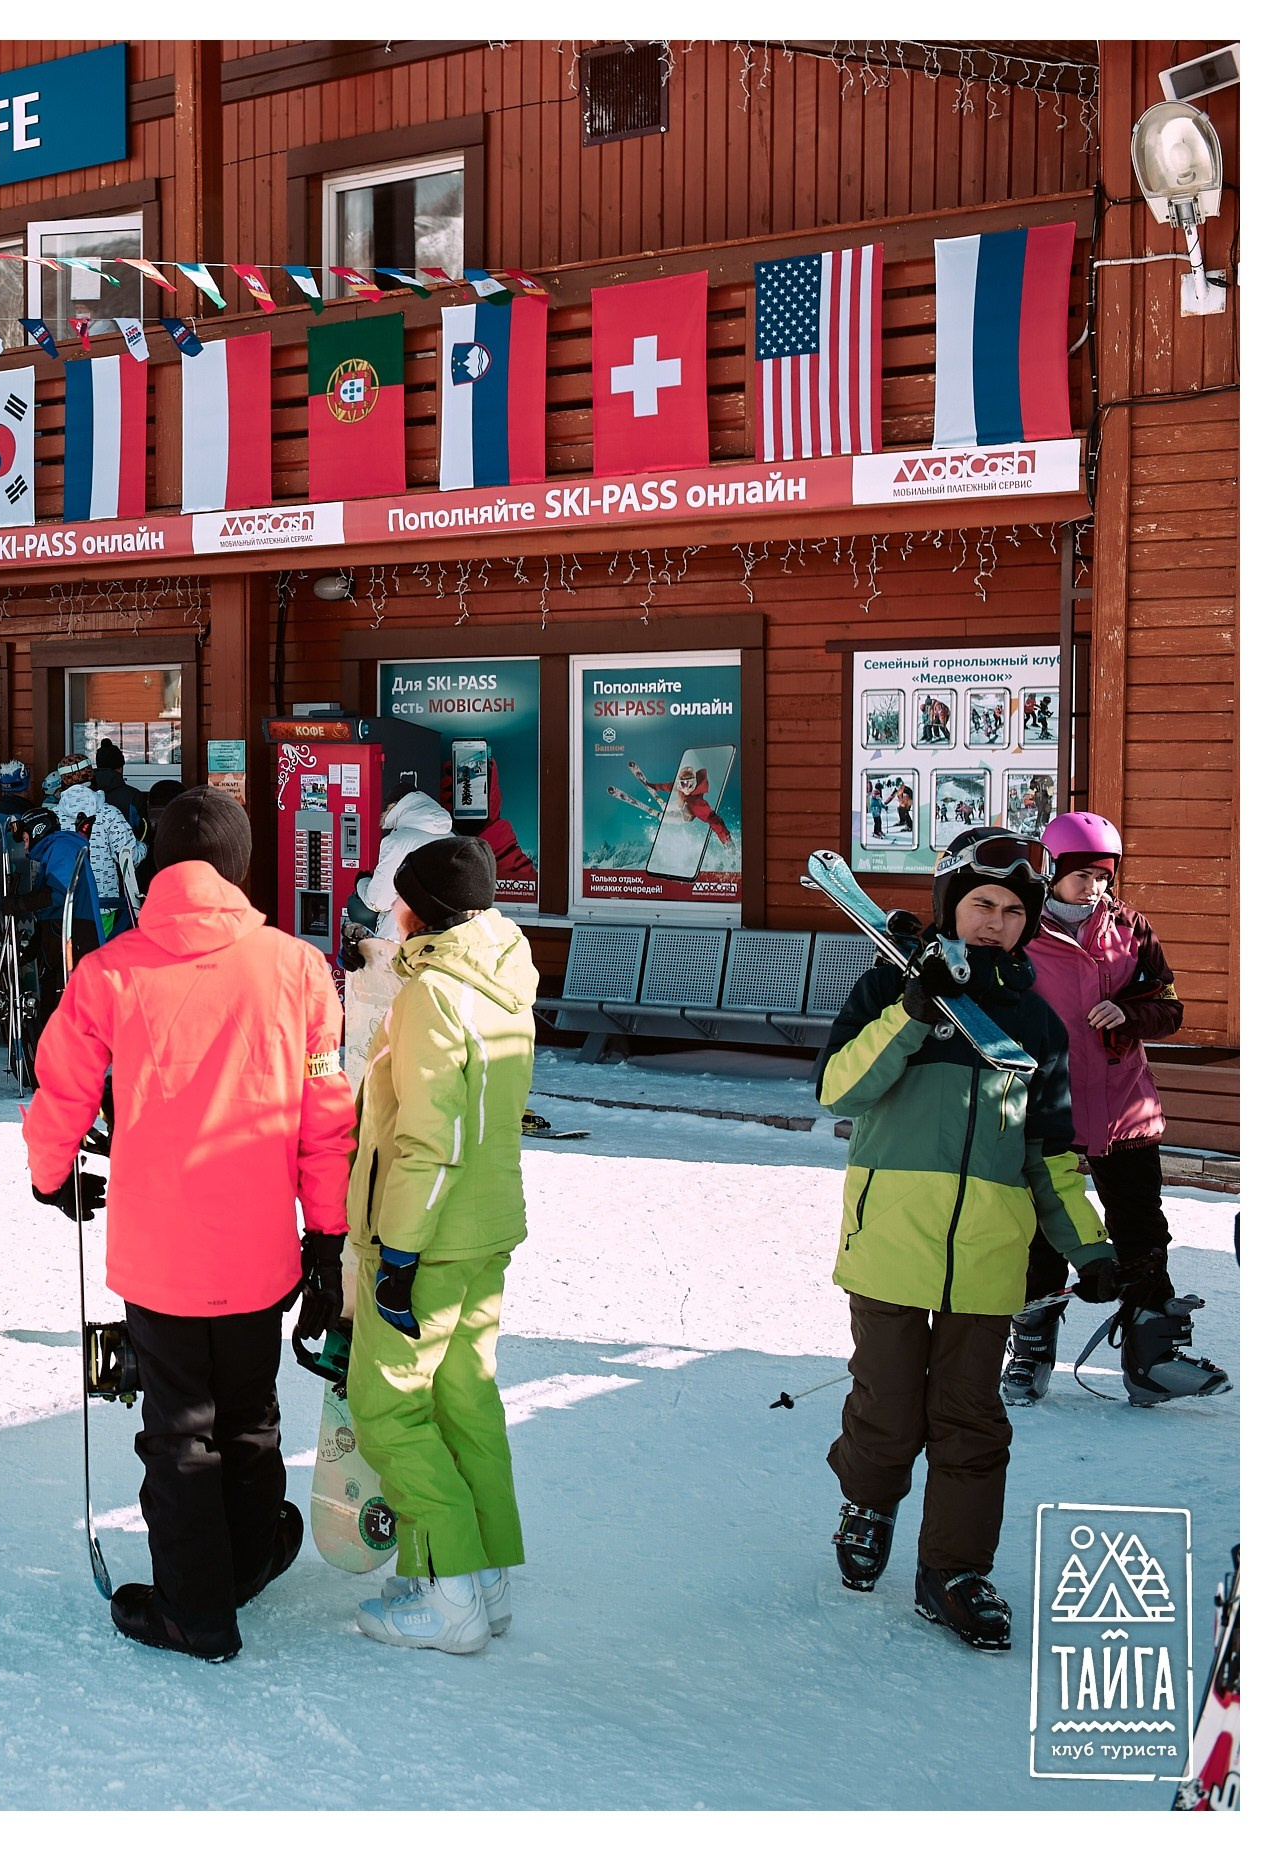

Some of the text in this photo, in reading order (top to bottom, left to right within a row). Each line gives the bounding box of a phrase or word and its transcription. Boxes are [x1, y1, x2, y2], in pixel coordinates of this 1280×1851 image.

[893, 450, 1036, 483] MobiCash
[892, 479, 1032, 497] МОБИЛЬНЫЙ ПЛАТЕЖНЫЙ СЕРВИС
[388, 471, 807, 533] Пополняйте SKI-PASS онлайн
[219, 511, 315, 537] MobiCash
[82, 528, 165, 554] онлайн
[220, 534, 313, 548] МОБИЛЬНЫЙ ПЛАТЕЖНЫЙ СЕРВИС
[864, 657, 929, 670] Семейный
[933, 654, 1028, 669] горнолыжный
[392, 675, 497, 695] Для SKI-PASS
[593, 679, 682, 694] Пополняйте
[912, 672, 1013, 684] «Медвежонок»
[392, 697, 515, 714] есть MOBICASH
[593, 698, 733, 717] SKI-PASS онлайн
[295, 725, 325, 737] КОФЕ
[590, 874, 644, 885] Только отдых,
[590, 885, 663, 895] никаких очередей!
